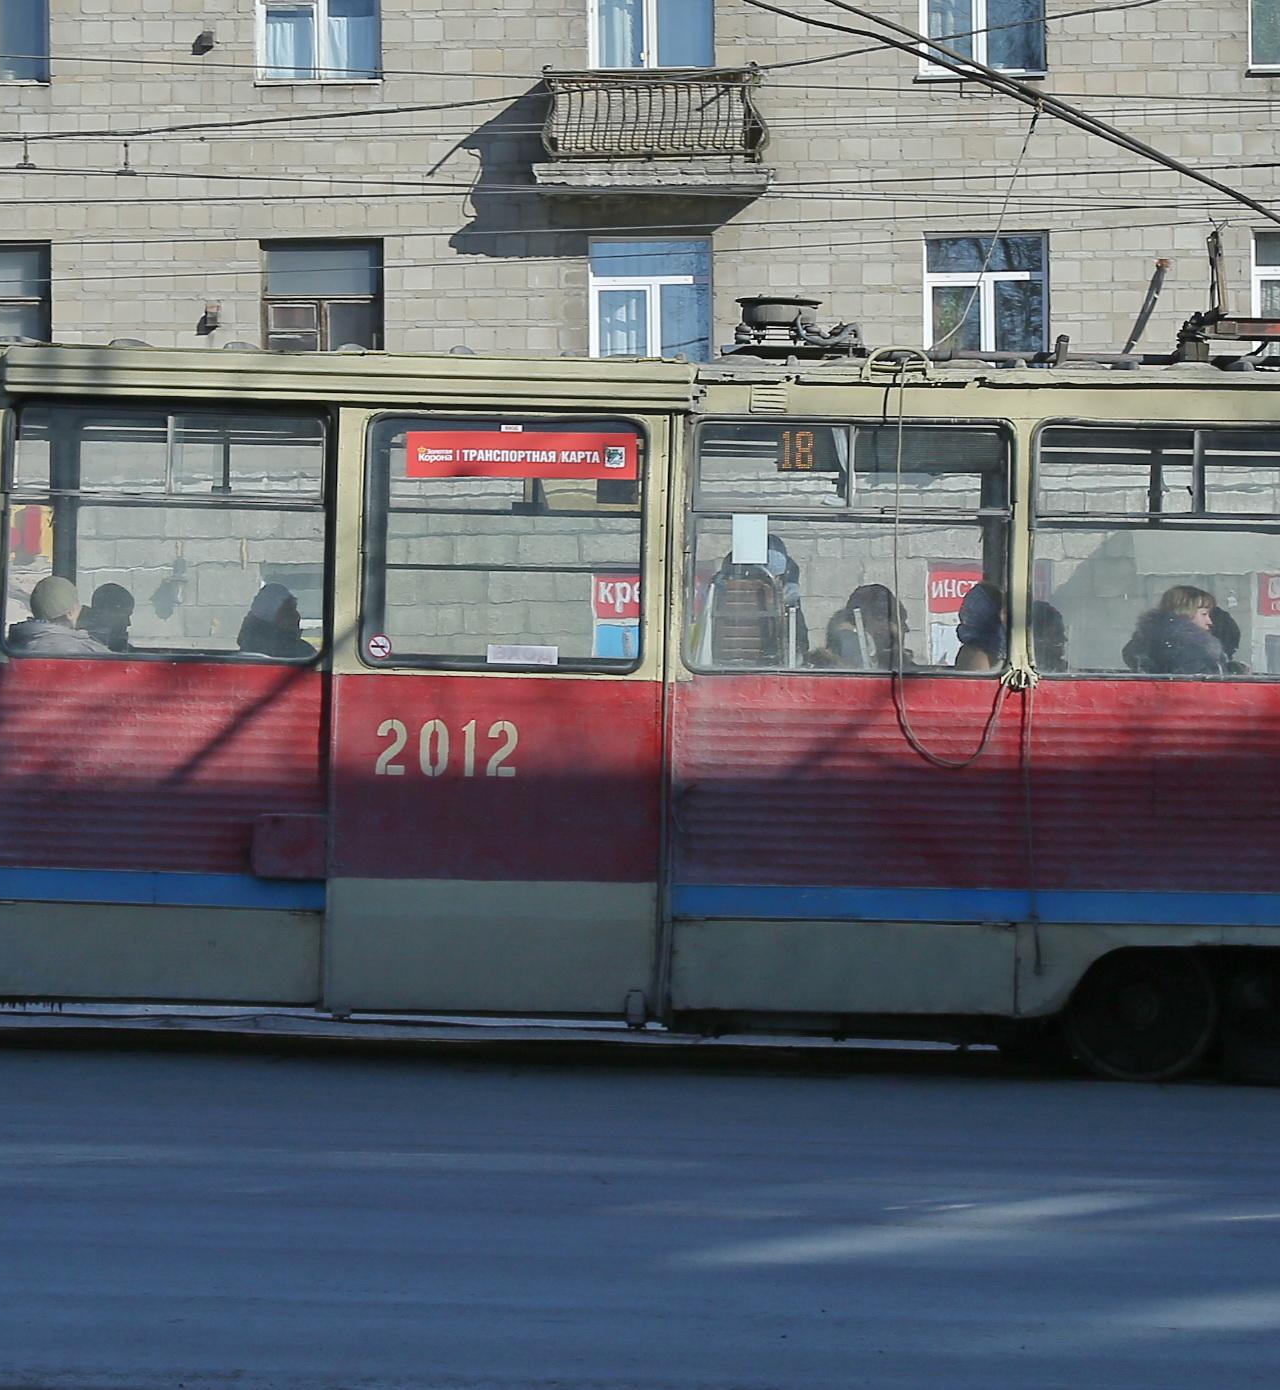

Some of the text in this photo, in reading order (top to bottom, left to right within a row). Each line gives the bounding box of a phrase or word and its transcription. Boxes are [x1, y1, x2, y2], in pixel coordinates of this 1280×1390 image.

[418, 453, 453, 463] Корона
[462, 449, 600, 463] ТРАНСПОРТНАЯ КАРТА
[782, 431, 814, 469] 18
[375, 719, 518, 777] 2012
